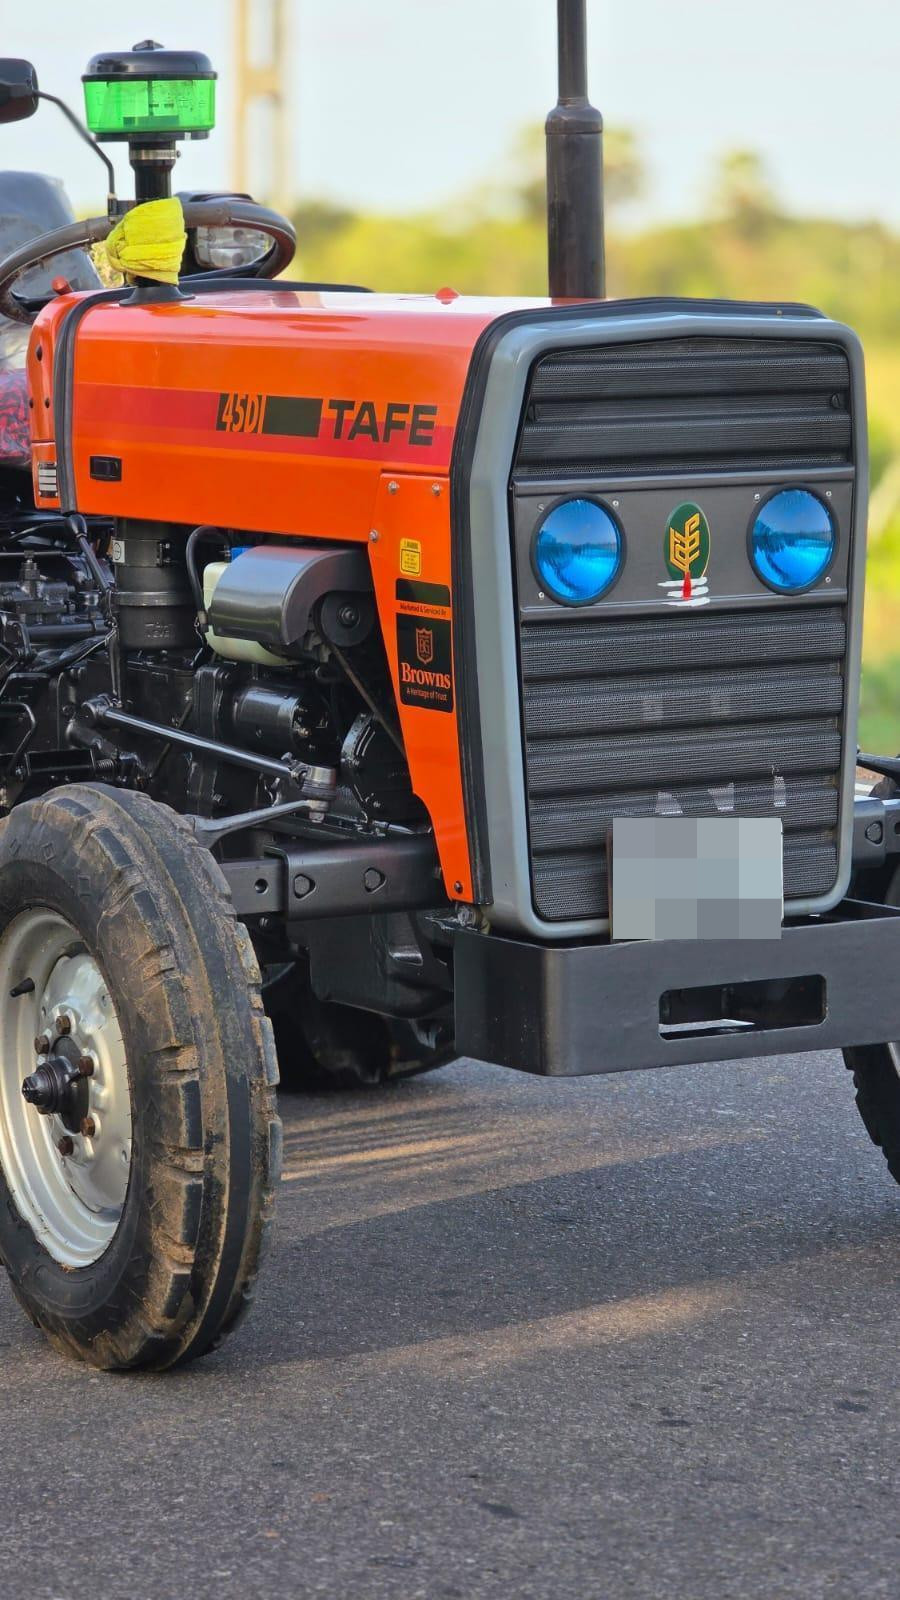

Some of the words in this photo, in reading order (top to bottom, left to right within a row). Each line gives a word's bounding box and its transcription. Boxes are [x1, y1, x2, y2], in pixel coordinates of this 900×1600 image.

[328, 398, 438, 446] TAFE
[400, 662, 451, 689] Browns
[411, 689, 429, 700] Heritage
